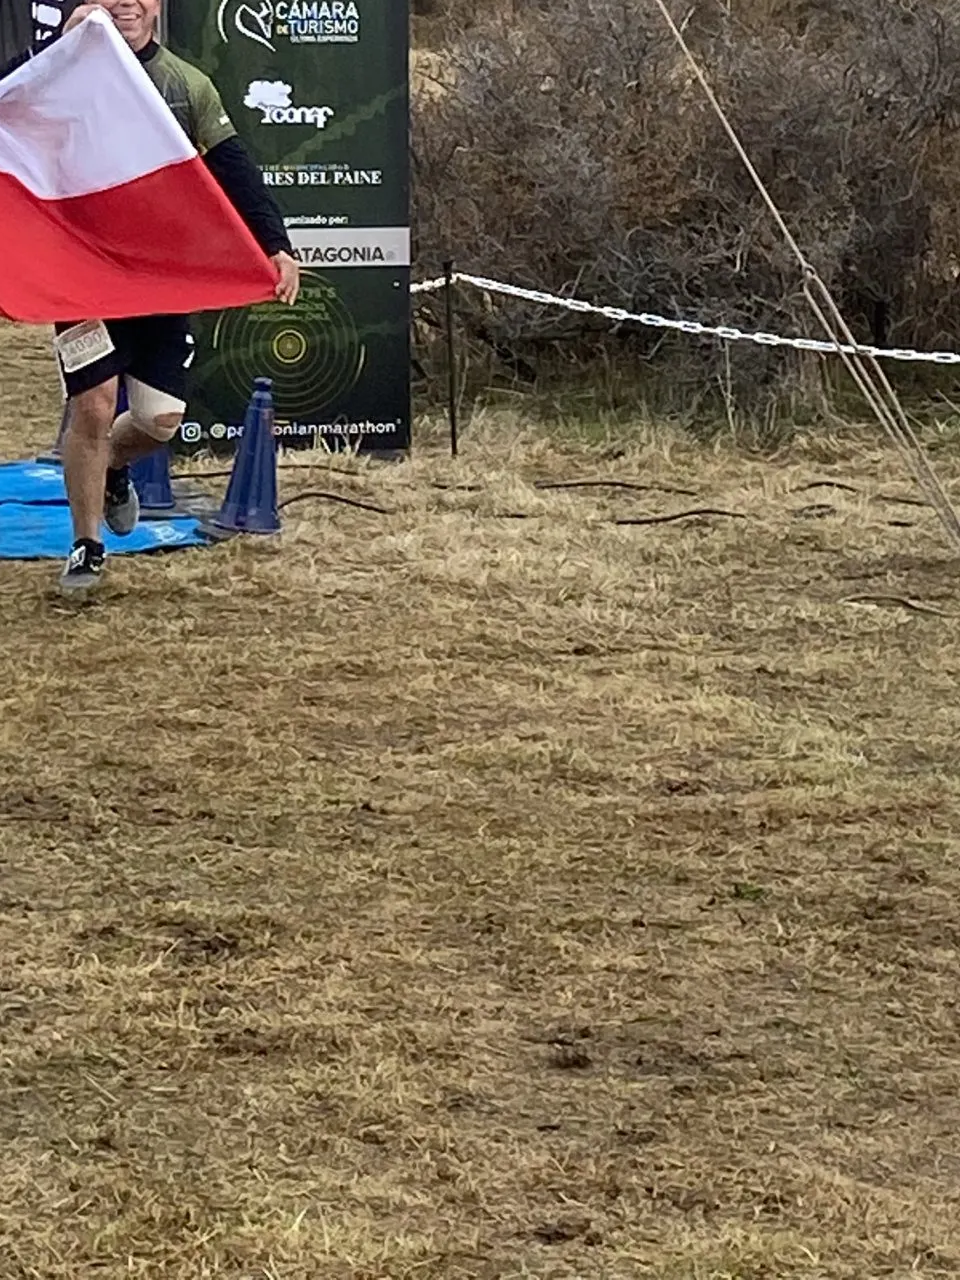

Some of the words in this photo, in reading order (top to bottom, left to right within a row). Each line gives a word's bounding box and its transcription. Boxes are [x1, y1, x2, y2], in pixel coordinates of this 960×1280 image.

[287, 19, 358, 35] TURISMO
[262, 171, 293, 185] RES
[297, 171, 331, 185] DEL
[333, 170, 382, 185] PAINE
[291, 246, 385, 263] ATAGONIA
